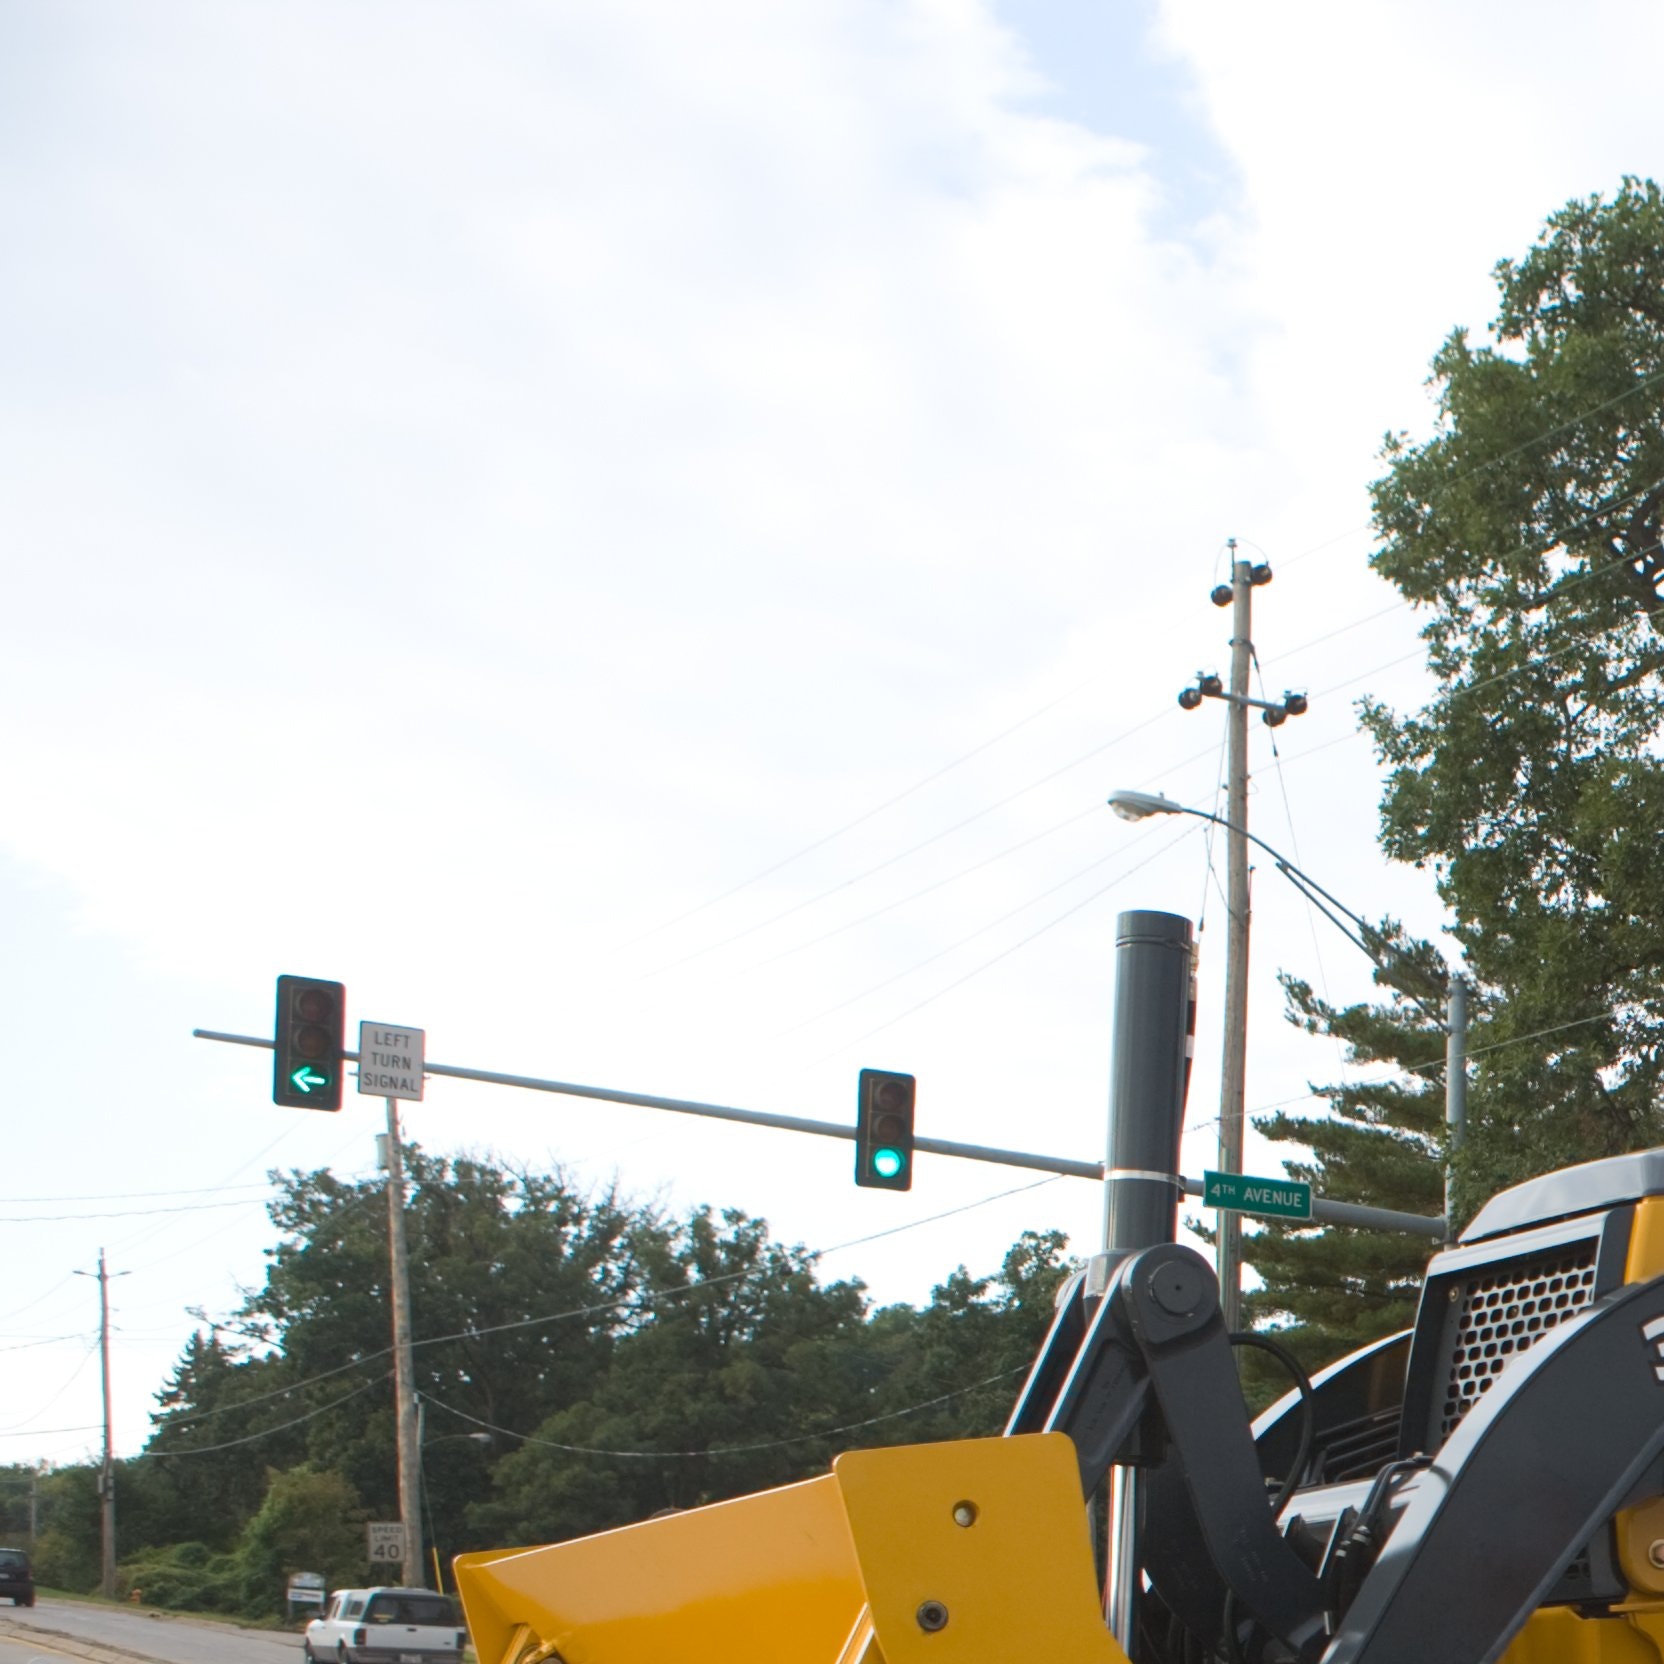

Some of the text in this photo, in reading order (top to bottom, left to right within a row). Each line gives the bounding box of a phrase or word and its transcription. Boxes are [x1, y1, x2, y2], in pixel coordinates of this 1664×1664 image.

[373, 1031, 411, 1050] LEFT
[371, 1051, 412, 1071] TURN
[363, 1072, 419, 1093] SIGNAL
[1210, 1183, 1302, 1207] 4TH AVENUE
[371, 1526, 403, 1534] SPEED
[374, 1534, 400, 1542] LIMIT
[373, 1544, 400, 1559] 40
